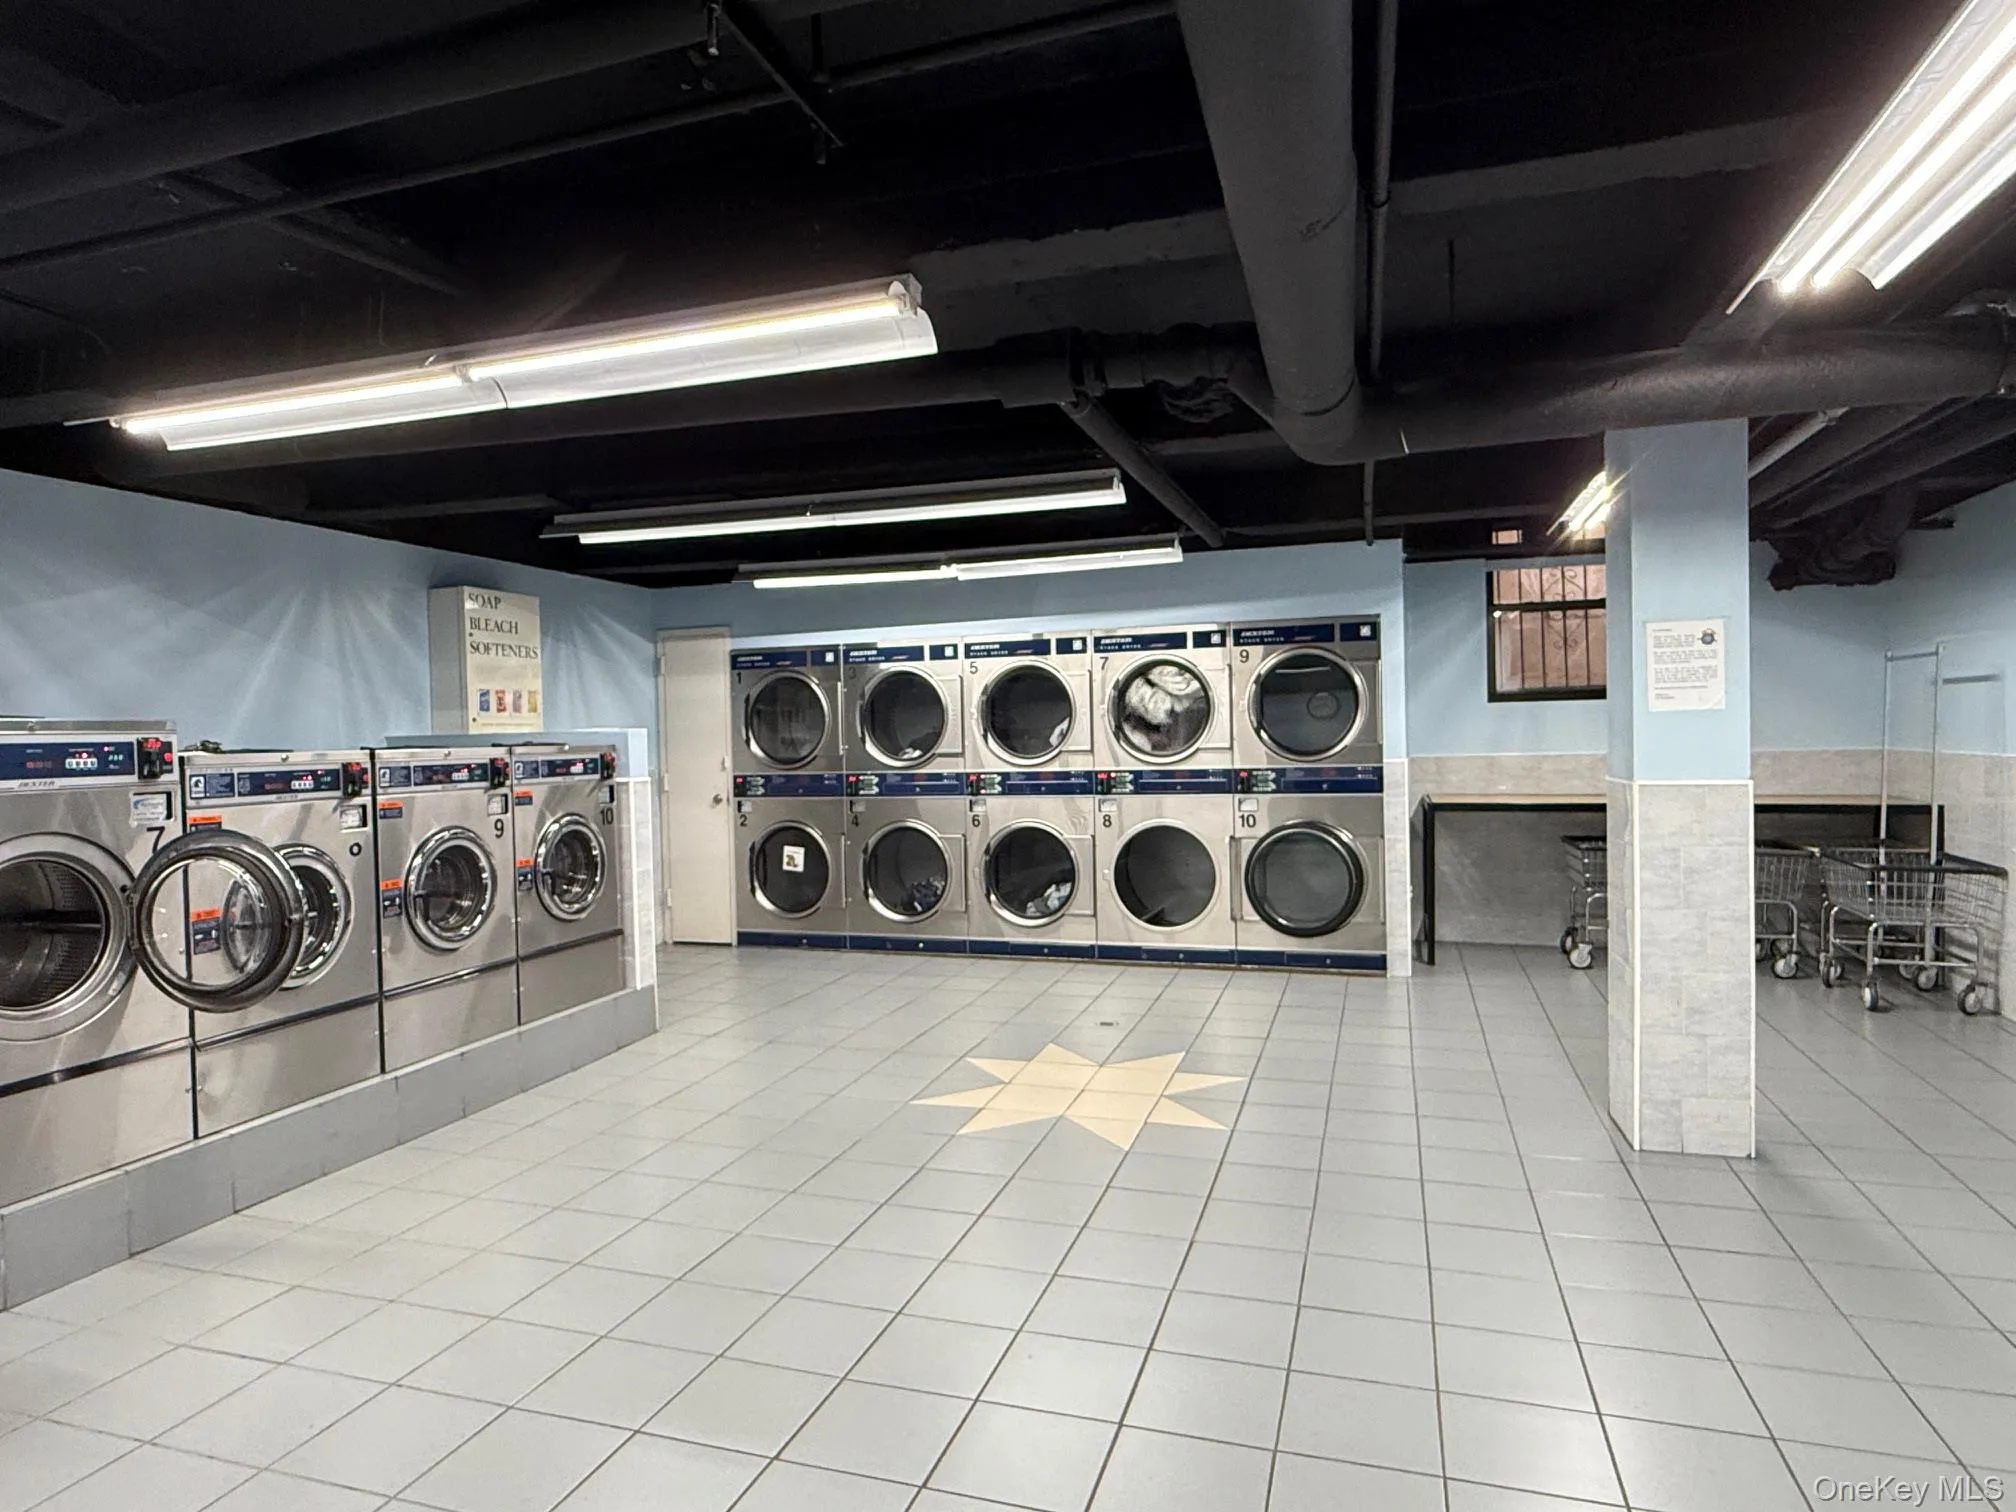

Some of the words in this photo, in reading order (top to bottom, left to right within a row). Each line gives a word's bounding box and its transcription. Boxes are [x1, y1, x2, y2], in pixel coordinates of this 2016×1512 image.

[468, 592, 501, 609] SOAP
[469, 616, 519, 635] BLEACH
[469, 640, 539, 660] SOFTENERS
[1239, 649, 1249, 663] 9
[969, 661, 978, 674] 5
[1099, 656, 1109, 670] 7
[736, 671, 742, 684] 1
[848, 666, 857, 679] 3
[600, 807, 614, 825] 10
[739, 815, 748, 826] 2
[851, 815, 860, 827] 4
[971, 815, 981, 828] 6
[1102, 814, 1112, 828] 8
[1239, 814, 1257, 828] 10
[494, 818, 505, 838] 9
[146, 826, 165, 853] 7
